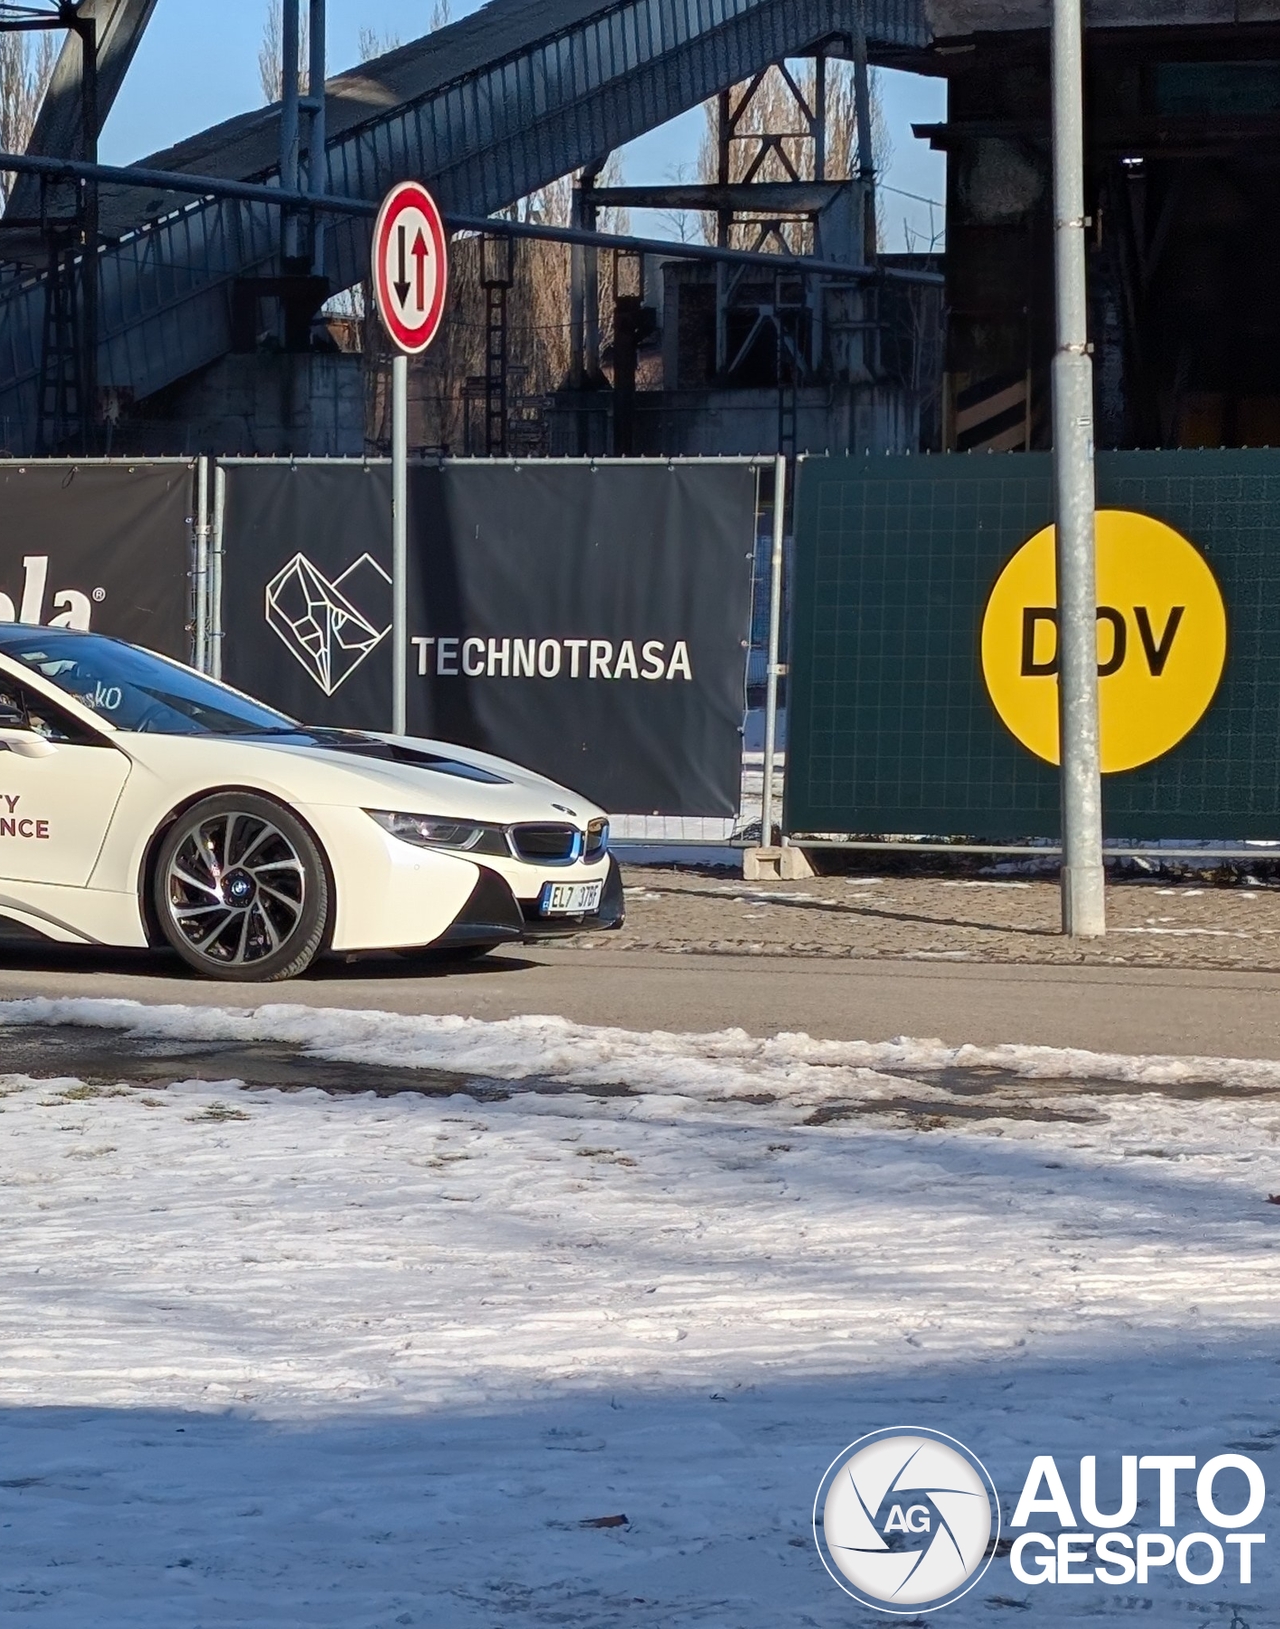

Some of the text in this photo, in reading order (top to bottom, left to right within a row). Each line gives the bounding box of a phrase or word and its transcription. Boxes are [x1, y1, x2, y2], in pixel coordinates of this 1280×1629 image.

[411, 635, 693, 681] TECHNOTRASA
[1020, 605, 1186, 677] DOV
[552, 886, 574, 908] EL7
